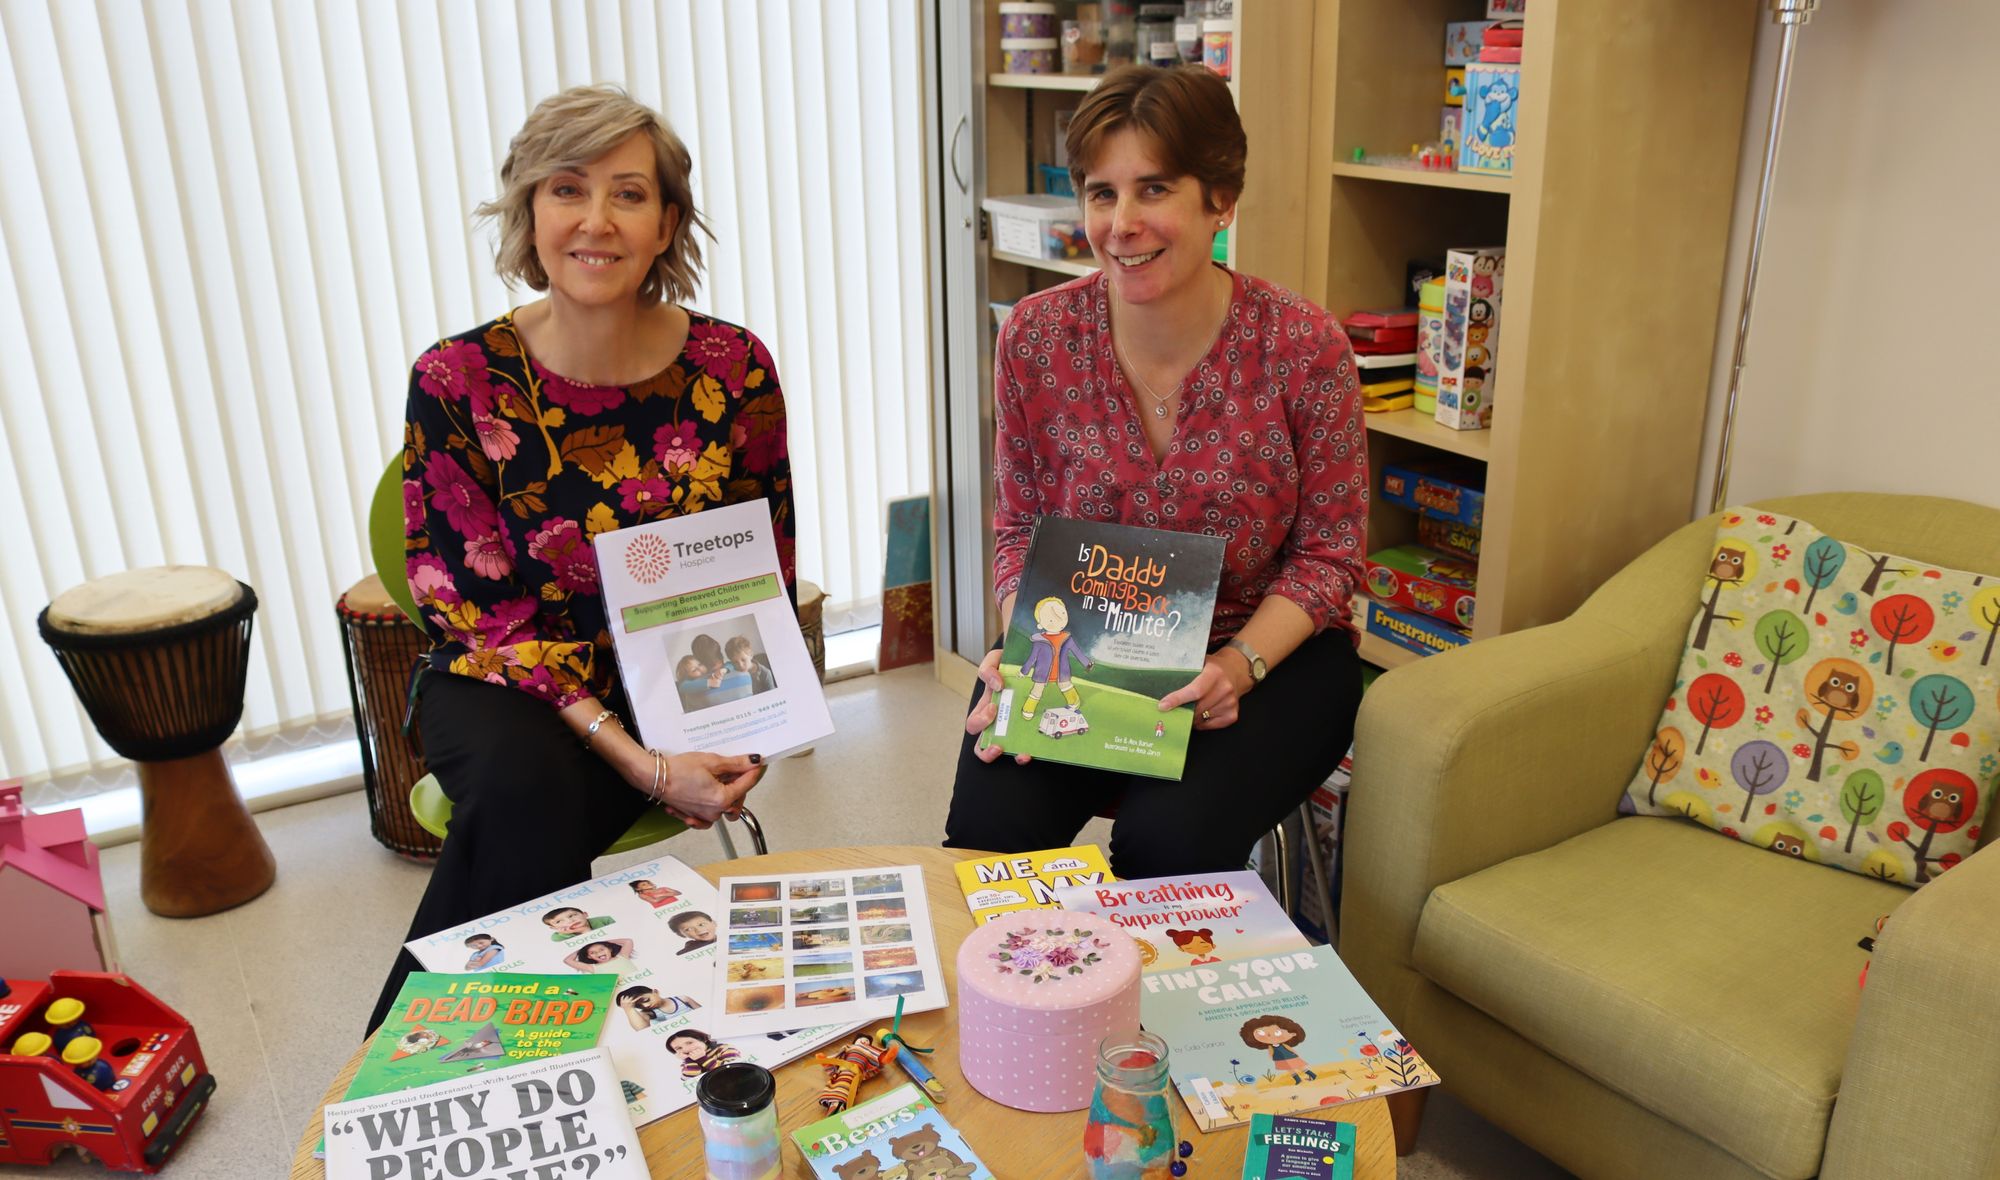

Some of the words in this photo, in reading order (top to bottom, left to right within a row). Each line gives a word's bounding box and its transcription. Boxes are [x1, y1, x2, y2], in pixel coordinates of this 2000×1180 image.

[673, 529, 754, 558] Treetops
[680, 554, 716, 569] Hospice
[1078, 543, 1091, 562] Is
[1087, 544, 1167, 588] Daddy
[634, 598, 677, 615] Supporting
[679, 589, 716, 604] Bereaved
[717, 583, 750, 595] Children
[751, 578, 766, 588] and
[666, 605, 698, 617] Families
[709, 595, 740, 608] schools
[1071, 571, 1128, 600] Coming
[1123, 584, 1169, 615] Back
[1082, 594, 1094, 610] in
[1097, 596, 1109, 612] a
[1104, 606, 1181, 641] Minute?
[974, 858, 1038, 883] ME
[1051, 860, 1078, 870] and
[1027, 872, 1104, 905] MY
[1095, 882, 1235, 908] Breathing
[428, 926, 476, 947] How
[480, 915, 511, 930] Do
[512, 901, 551, 917] You
[553, 886, 596, 903] Feel
[595, 863, 662, 889] Today?
[654, 899, 692, 919] proud
[1109, 904, 1242, 930] Superpower
[564, 928, 608, 949] bored
[1142, 968, 1220, 994] FIND
[1228, 952, 1320, 980] YOUR
[447, 983, 457, 994] I
[463, 982, 537, 995] Found
[545, 985, 560, 995] a
[1198, 976, 1292, 1005] CALM
[403, 997, 497, 1023] DEAD
[503, 999, 595, 1025] BIRD
[514, 1029, 526, 1038] A
[528, 1029, 572, 1040] guide
[651, 1016, 691, 1036] tired
[517, 1039, 532, 1048] to
[537, 1039, 562, 1048] the
[141, 1083, 163, 1113] FIRE
[327, 1107, 366, 1118] Helping
[367, 1101, 390, 1111] Your
[391, 1096, 417, 1106] Child
[506, 1071, 528, 1081] Love
[530, 1066, 547, 1075] and
[549, 1054, 601, 1071] Illustrations
[511, 1069, 596, 1119] DO
[366, 1109, 597, 1180] PEOPLE
[819, 1106, 917, 1156] Bears
[1264, 1134, 1341, 1152] FEELINGS
[1274, 1126, 1302, 1135] LET'S
[1304, 1128, 1333, 1139] TALK:
